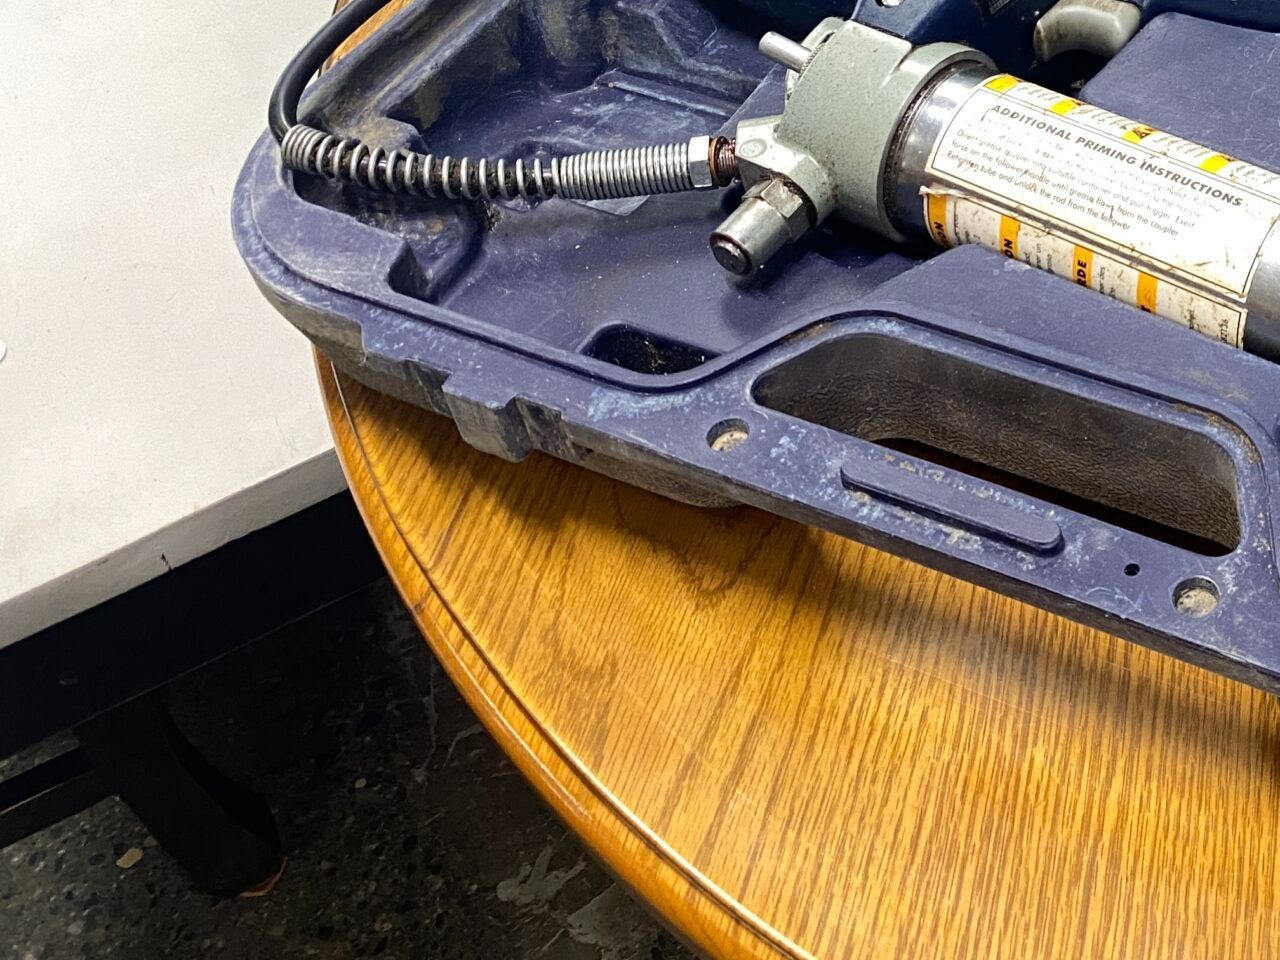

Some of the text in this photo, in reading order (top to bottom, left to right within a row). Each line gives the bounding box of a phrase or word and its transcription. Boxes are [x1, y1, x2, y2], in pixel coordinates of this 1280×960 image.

[980, 151, 994, 162] the
[1136, 214, 1149, 224] the
[991, 105, 1071, 141] ADDITIONAL
[1074, 136, 1137, 165] PRIMING
[1139, 159, 1243, 207] INSTRUCTIONS
[998, 171, 1013, 182] and
[1039, 188, 1052, 198] the
[1052, 193, 1067, 204] rod
[1067, 199, 1085, 212] from
[1086, 207, 1099, 217] the
